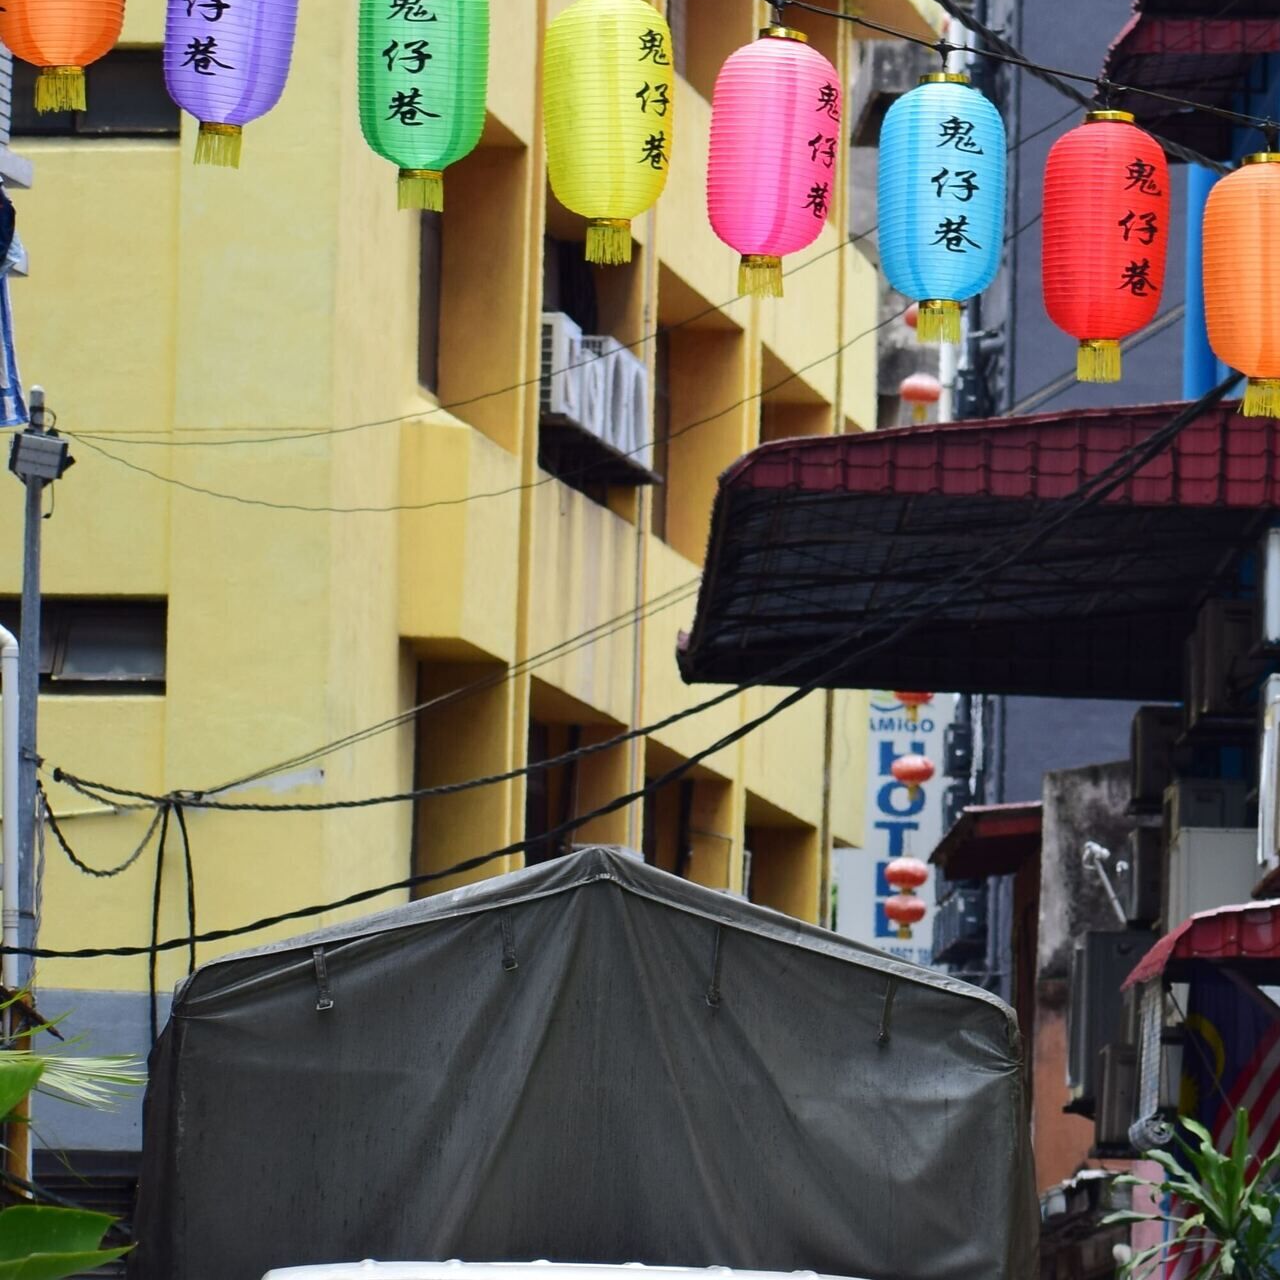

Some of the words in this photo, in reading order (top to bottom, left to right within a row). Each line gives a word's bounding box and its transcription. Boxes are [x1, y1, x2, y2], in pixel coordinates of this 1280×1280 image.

[634, 28, 672, 171] 鬼仔巷
[801, 81, 840, 219] 鬼仔巷
[930, 115, 984, 254] 鬼仔巷
[1116, 157, 1163, 298] 鬼仔巷
